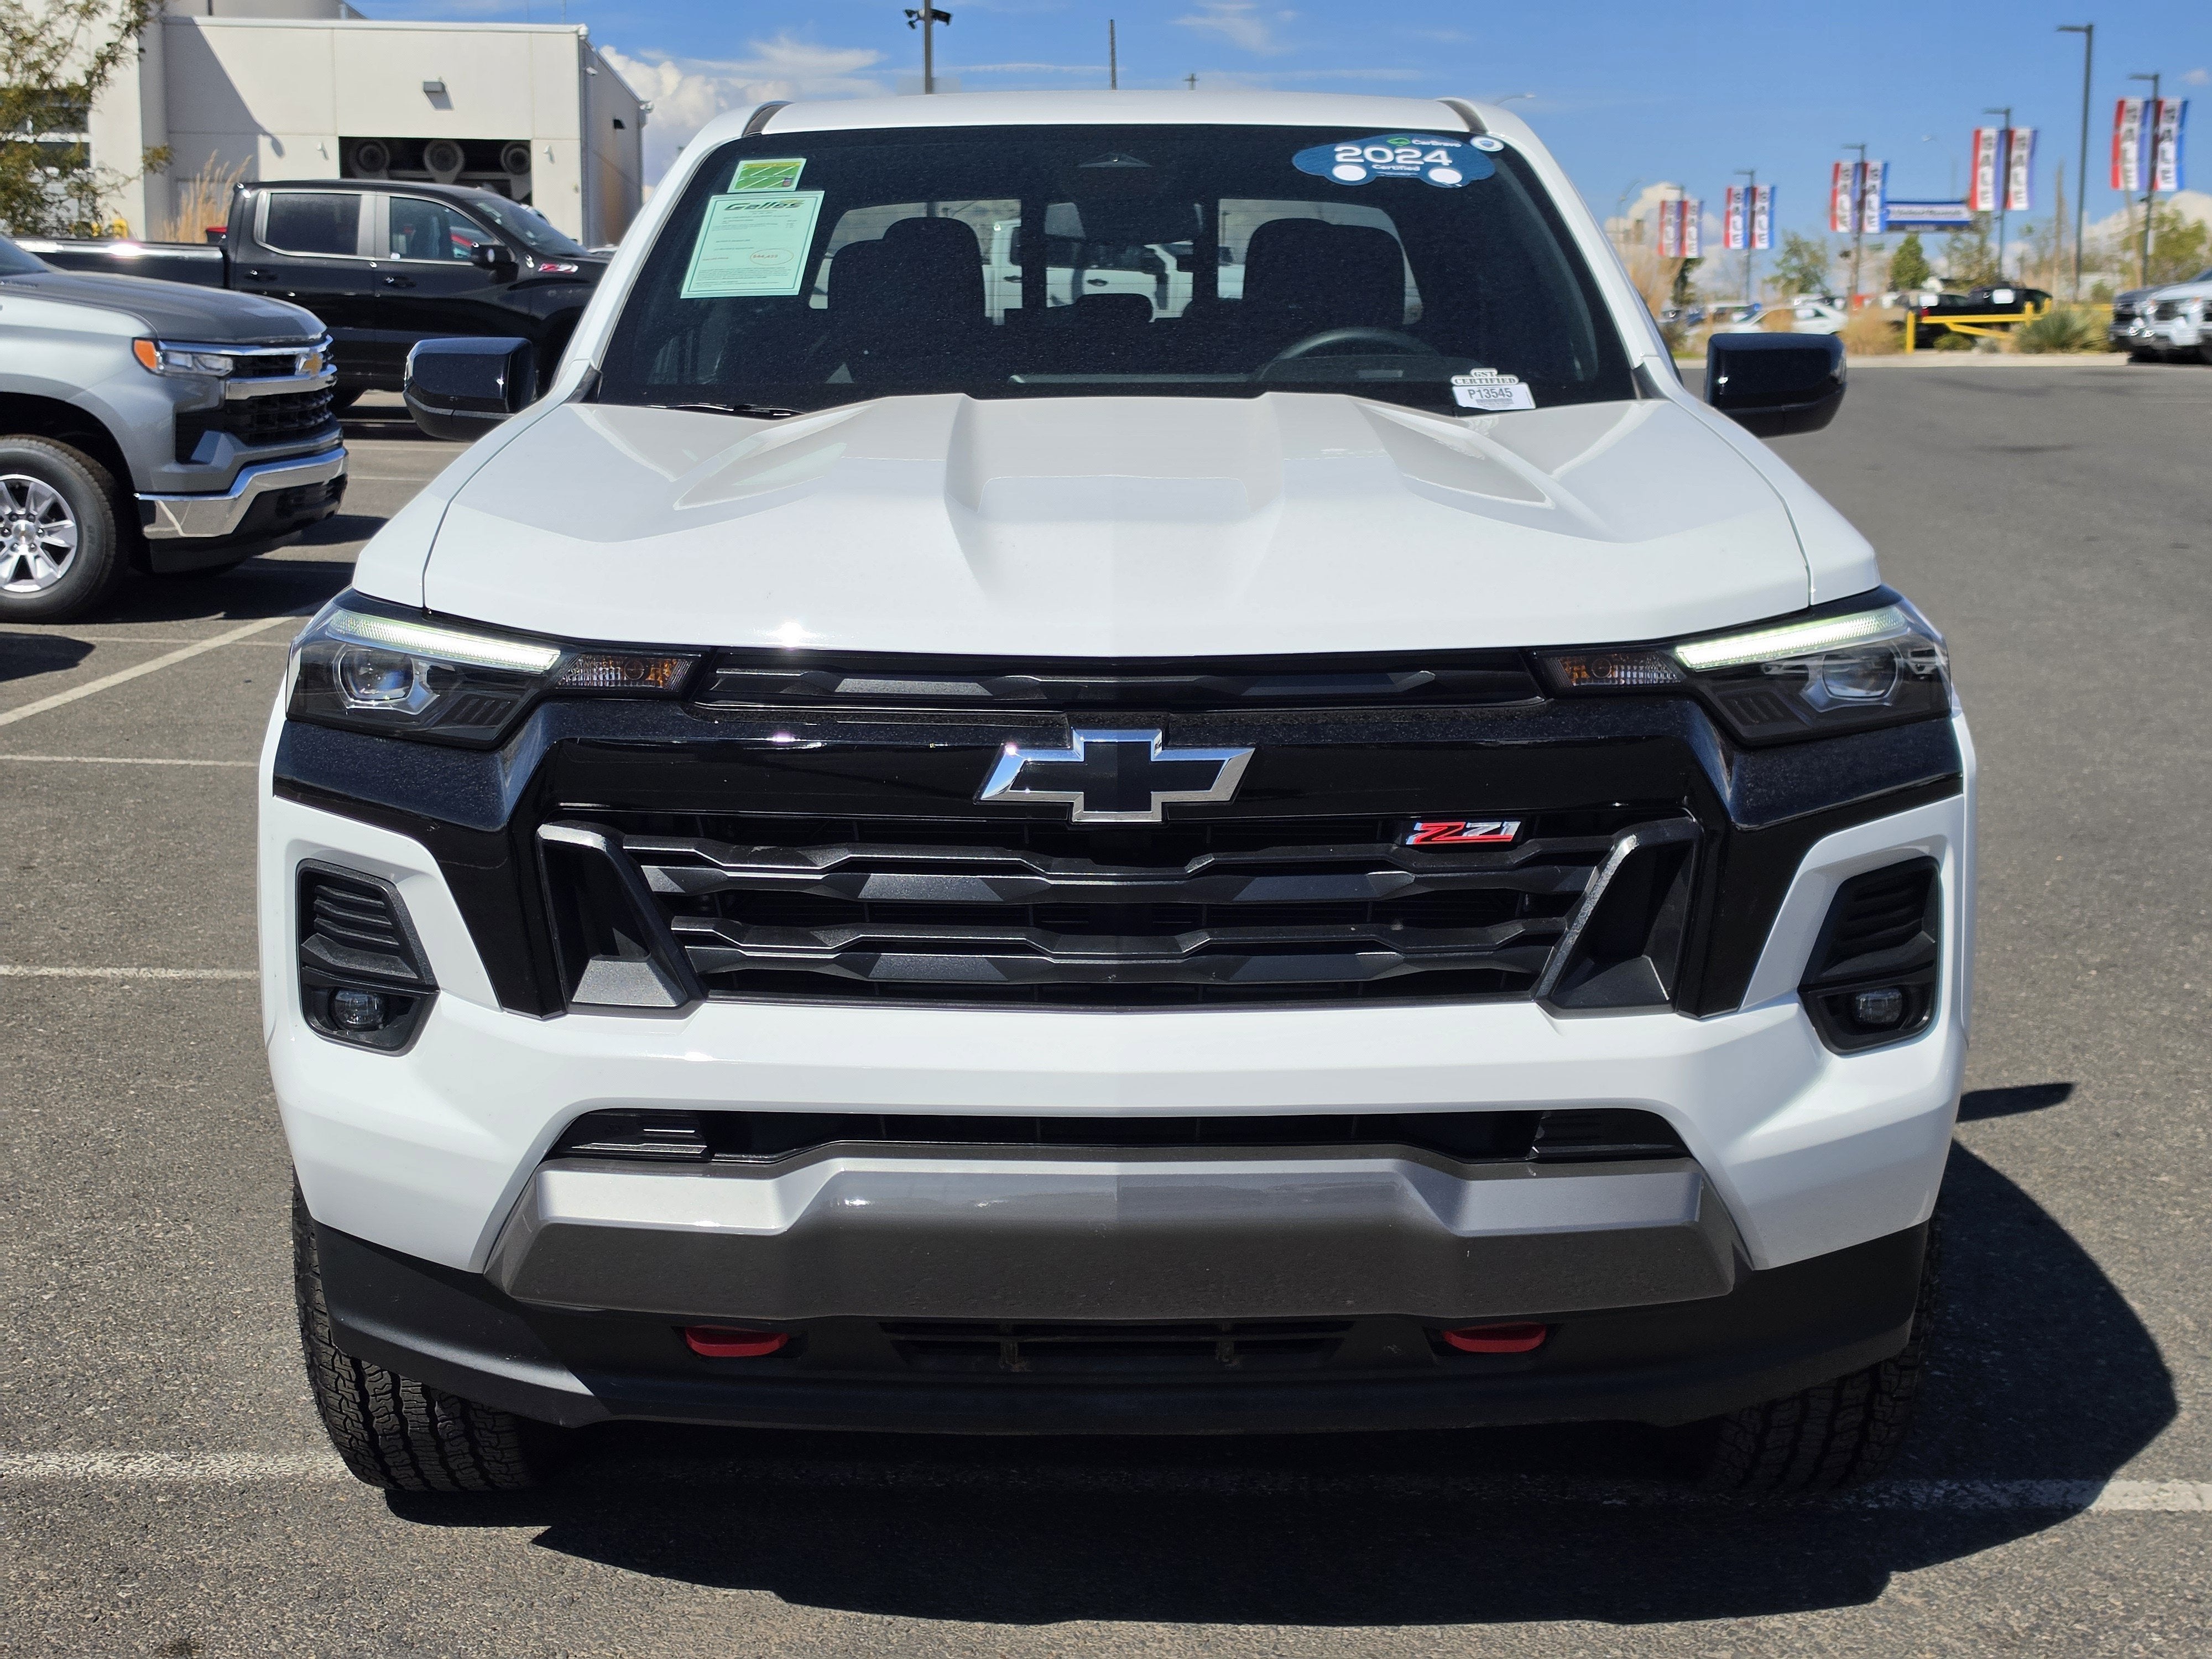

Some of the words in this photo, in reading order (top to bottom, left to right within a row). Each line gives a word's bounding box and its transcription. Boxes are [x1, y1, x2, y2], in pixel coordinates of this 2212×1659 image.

[2159, 105, 2176, 184] SALE
[1334, 146, 1452, 165] 2024
[724, 201, 805, 211] Galles
[1467, 388, 1513, 399] P13545
[1406, 821, 1521, 844] Z71
